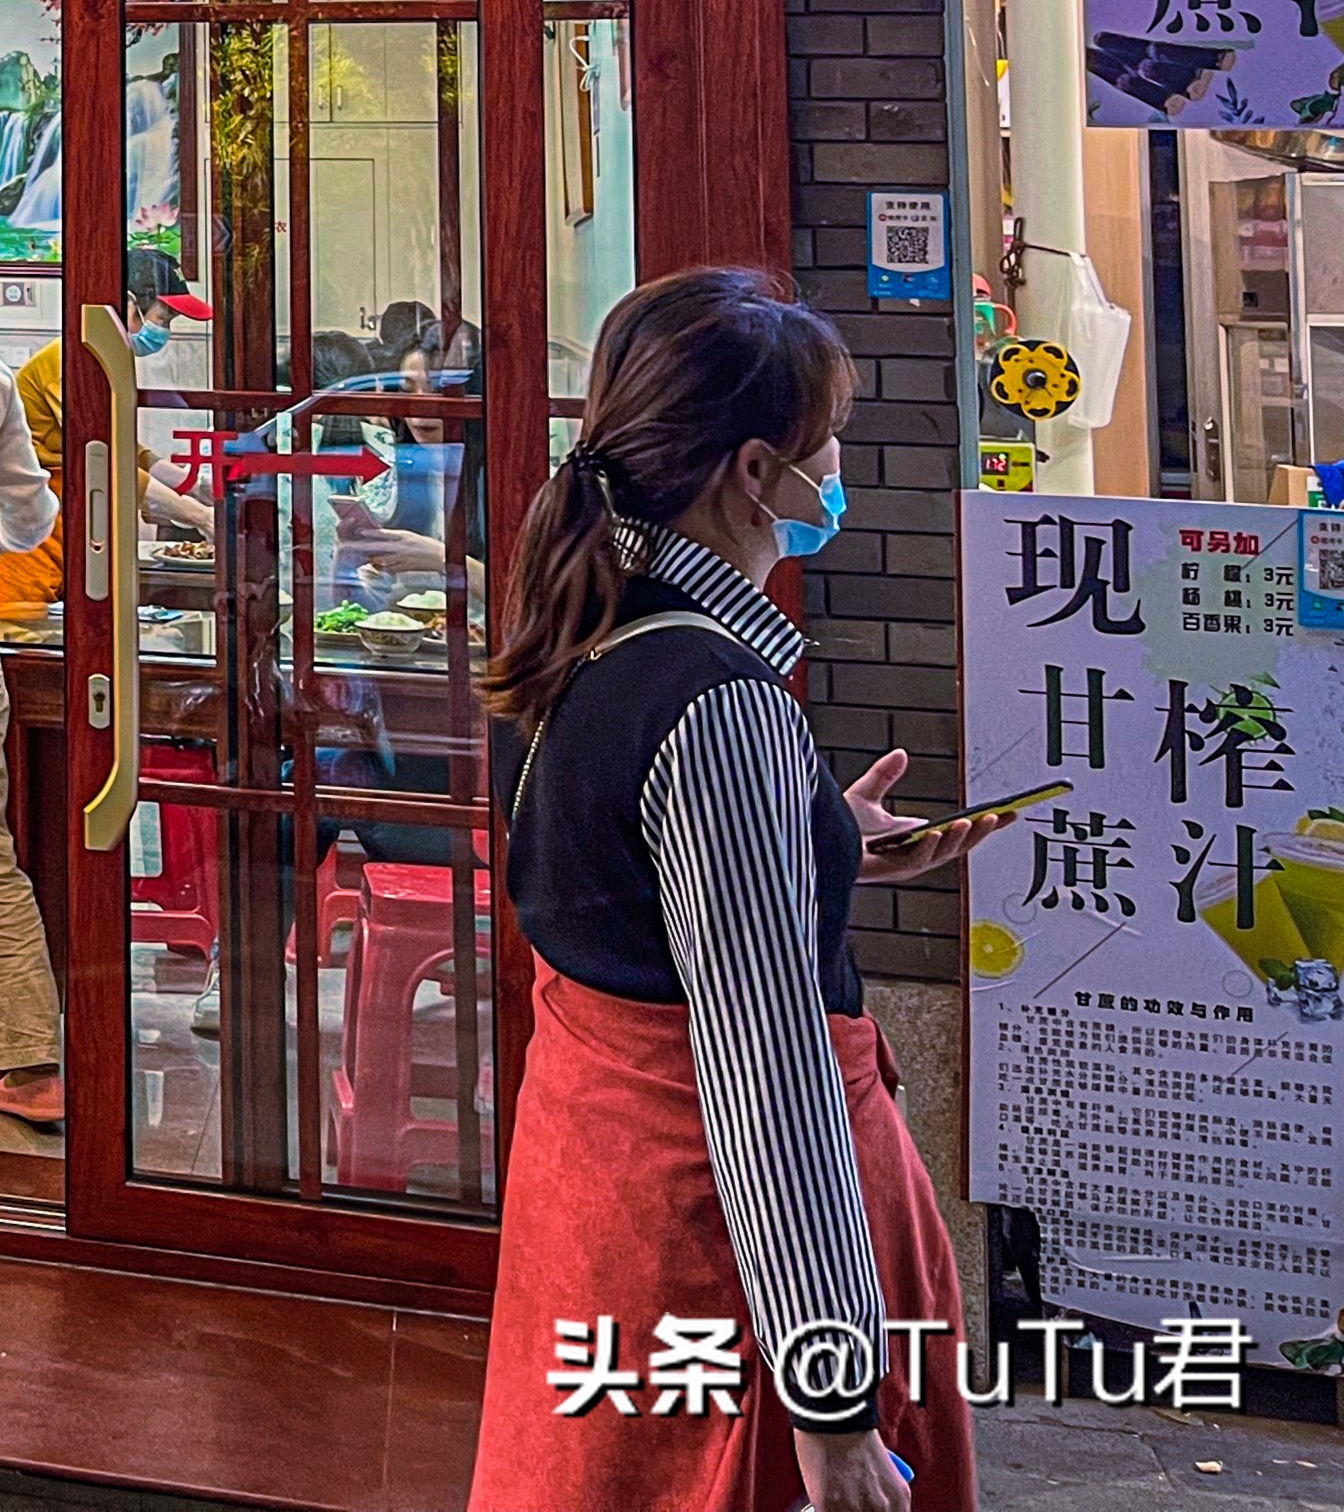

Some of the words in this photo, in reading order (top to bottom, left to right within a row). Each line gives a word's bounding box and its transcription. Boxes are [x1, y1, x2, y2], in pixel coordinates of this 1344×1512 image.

[171, 430, 239, 499] 开
[1179, 529, 1260, 556] 可另加
[1075, 991, 1253, 1023] 甘蔗的功效与作用
